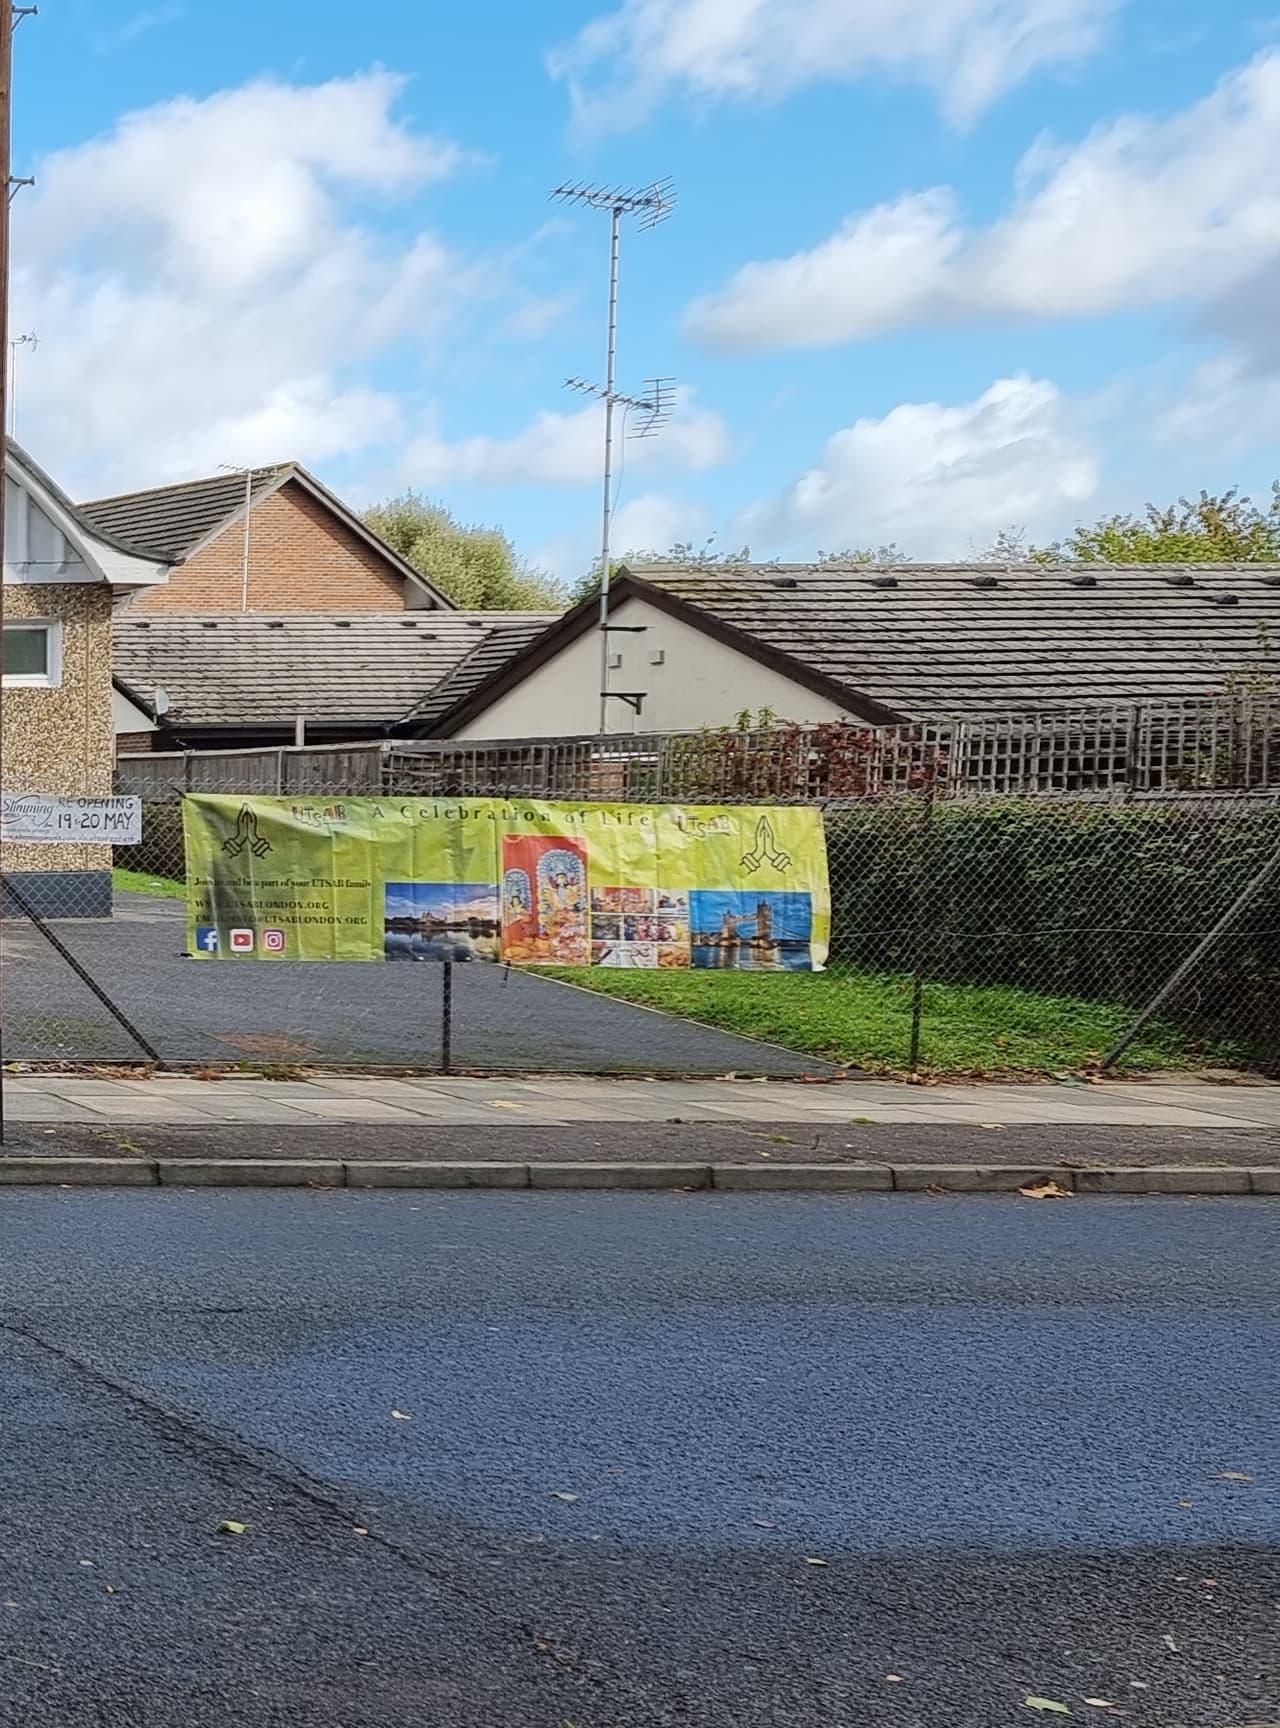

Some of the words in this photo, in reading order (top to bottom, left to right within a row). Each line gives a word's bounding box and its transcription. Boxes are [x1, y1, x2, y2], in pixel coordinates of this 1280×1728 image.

[58, 813, 72, 828] 19
[81, 813, 100, 829] 20
[104, 811, 134, 829] MAY
[372, 806, 385, 819] A
[400, 803, 551, 822] Celebration
[565, 811, 586, 824] of
[602, 812, 650, 826] Life
[261, 880, 279, 889] part
